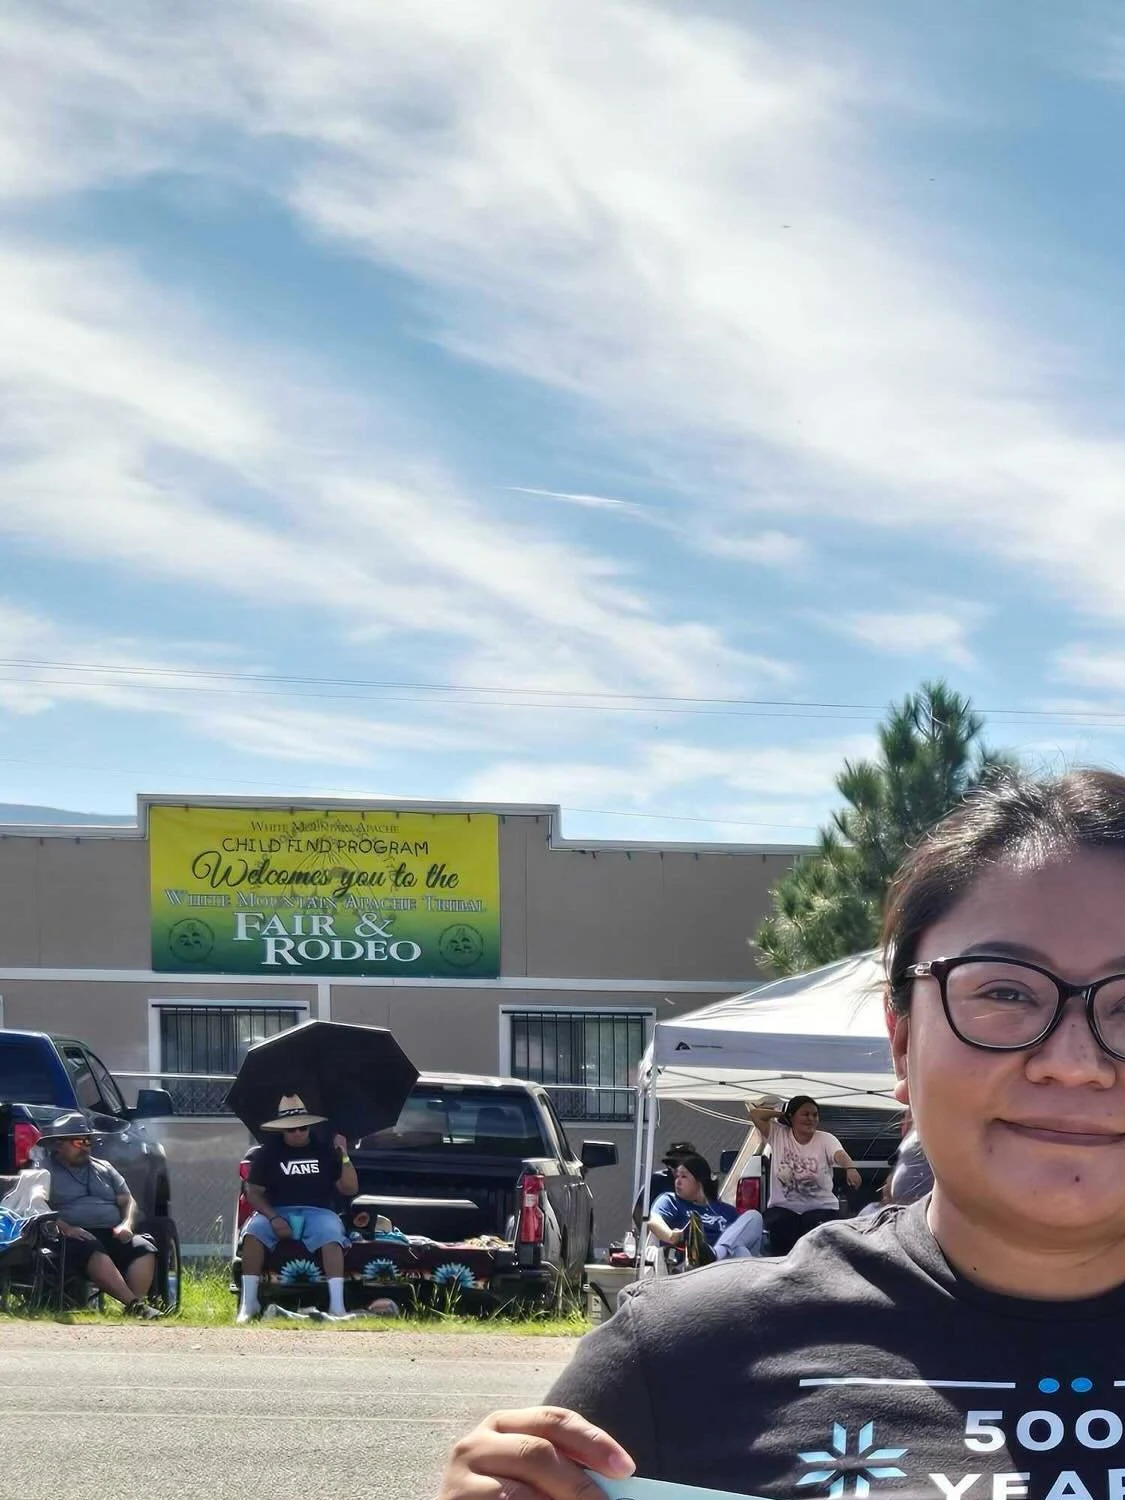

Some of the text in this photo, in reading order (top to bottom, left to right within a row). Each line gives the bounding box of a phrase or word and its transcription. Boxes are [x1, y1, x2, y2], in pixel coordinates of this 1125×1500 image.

[222, 837, 429, 856] CHILD FIND PROGRAM
[192, 851, 460, 897] Welcomes you to the
[232, 911, 393, 941] FAIR &
[260, 937, 422, 966] RODEO
[280, 1159, 320, 1175] VANS
